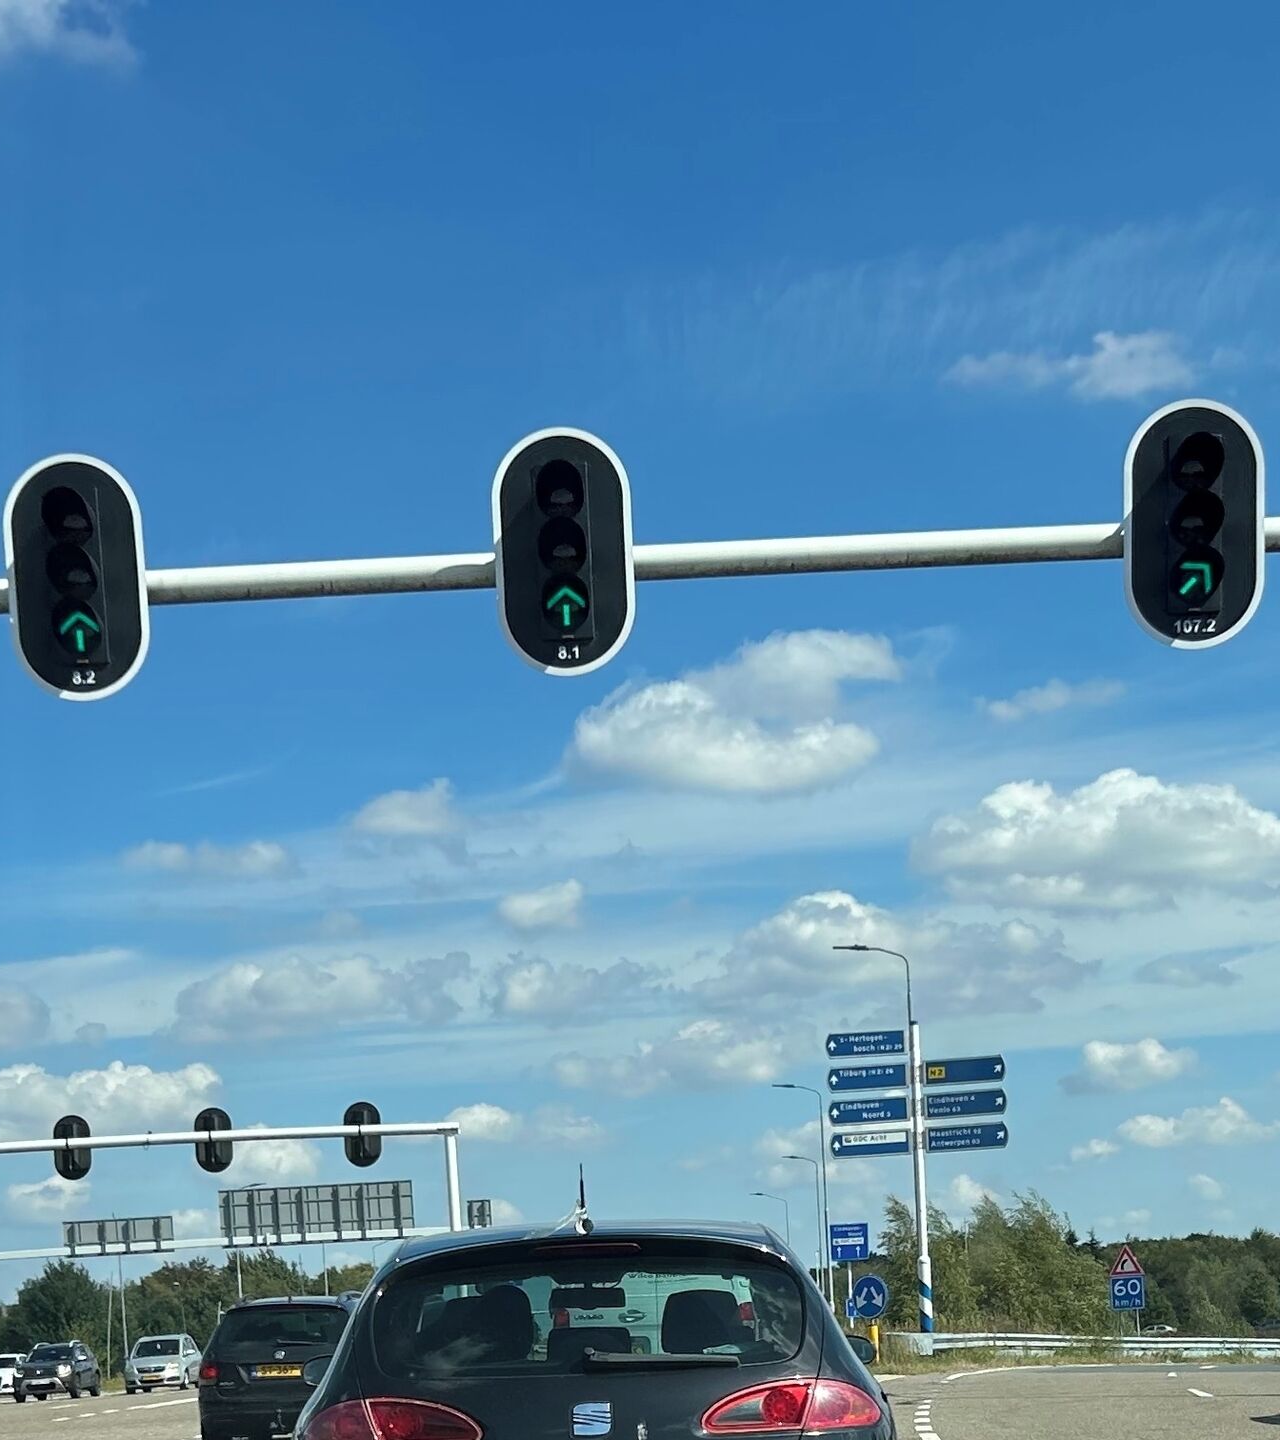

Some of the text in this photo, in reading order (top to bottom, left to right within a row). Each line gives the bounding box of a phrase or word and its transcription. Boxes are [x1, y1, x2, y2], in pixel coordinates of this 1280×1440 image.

[1174, 619, 1217, 633] 107.2
[558, 645, 579, 659] 8.1
[72, 670, 96, 685] 8.2
[1114, 1279, 1140, 1296] 60
[1114, 1297, 1141, 1307] km/h
